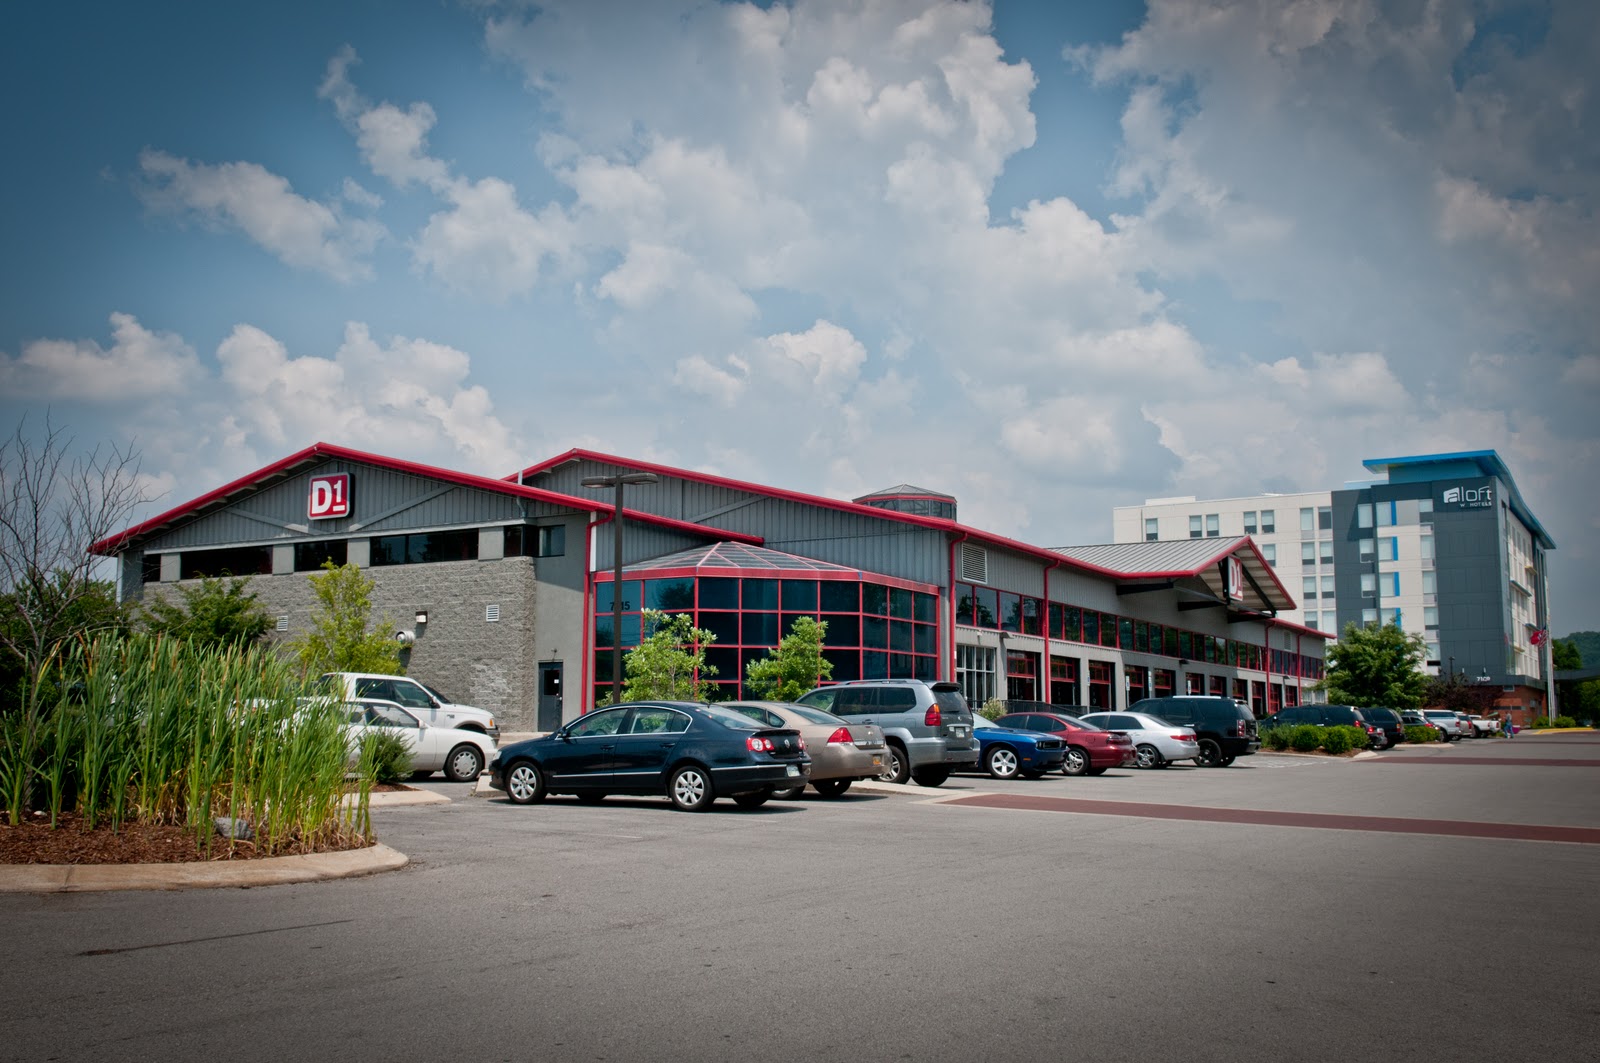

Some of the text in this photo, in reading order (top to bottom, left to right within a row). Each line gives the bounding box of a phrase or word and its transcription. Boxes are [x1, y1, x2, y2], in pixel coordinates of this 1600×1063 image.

[311, 480, 346, 514] D1
[1443, 486, 1492, 503] aloft
[609, 601, 631, 611] 715
